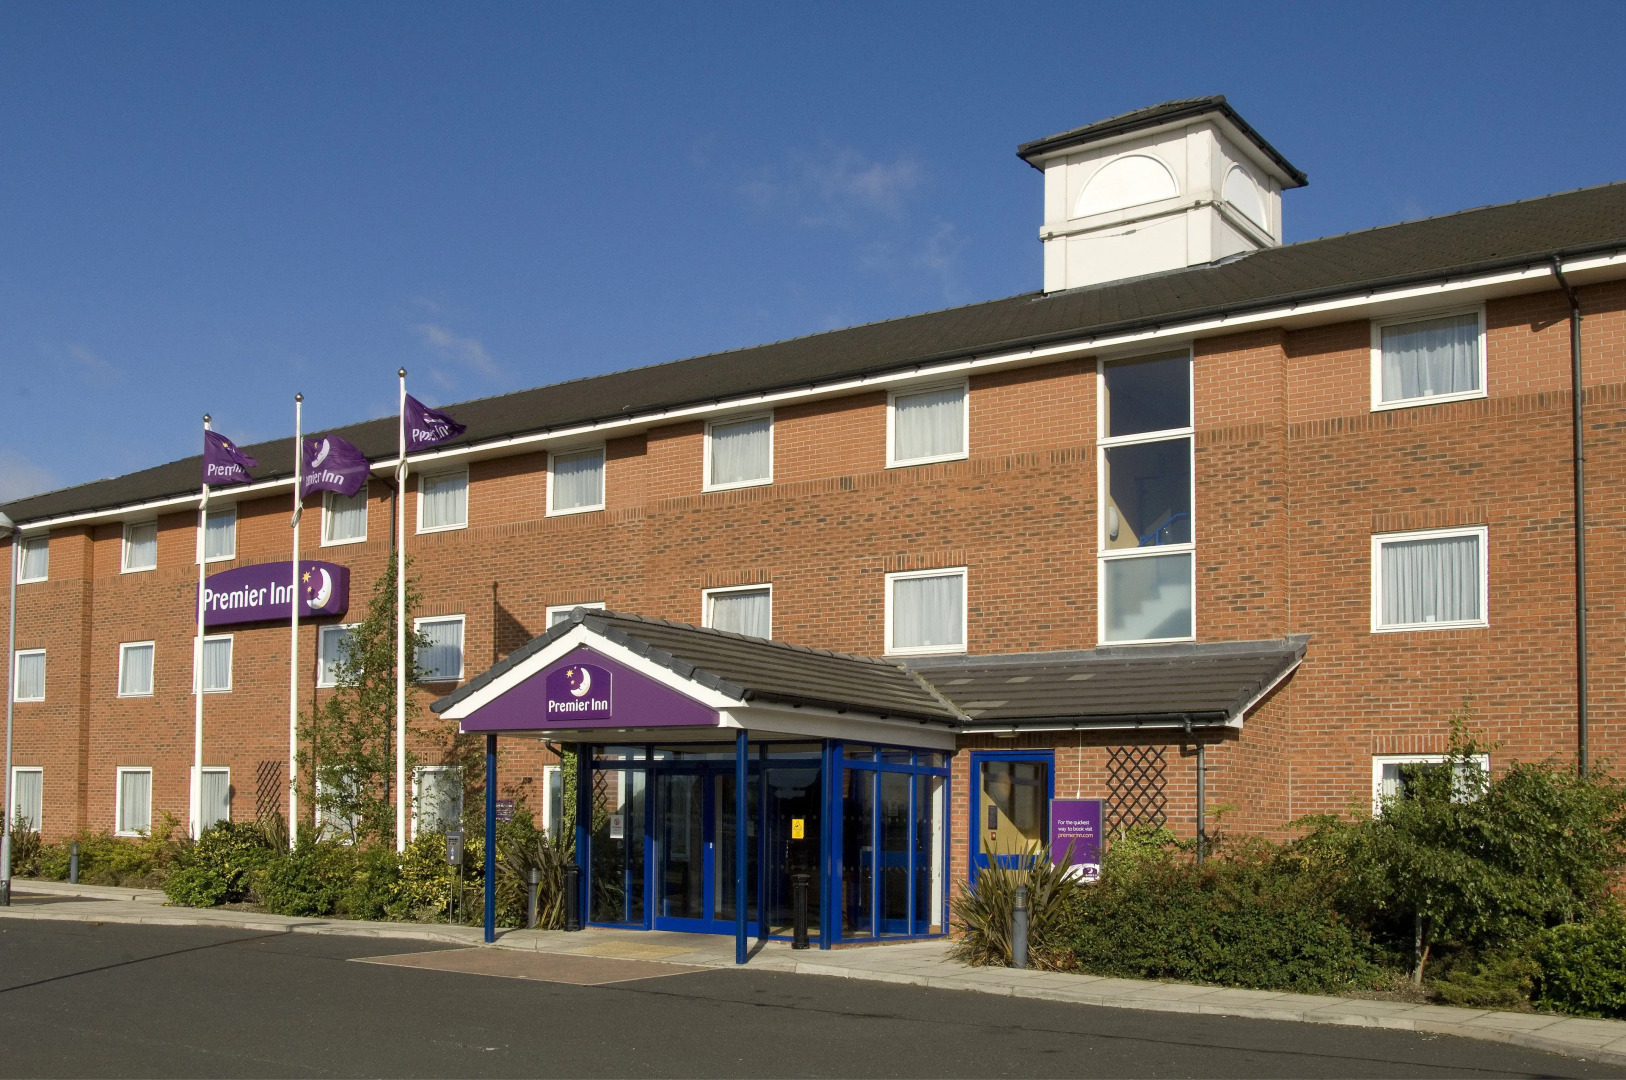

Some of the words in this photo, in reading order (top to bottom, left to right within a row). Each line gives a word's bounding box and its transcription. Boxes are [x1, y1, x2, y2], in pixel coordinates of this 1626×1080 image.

[321, 469, 344, 485] Inn
[204, 584, 267, 611] Premier
[548, 699, 590, 713] Premier
[591, 698, 608, 711] Inn
